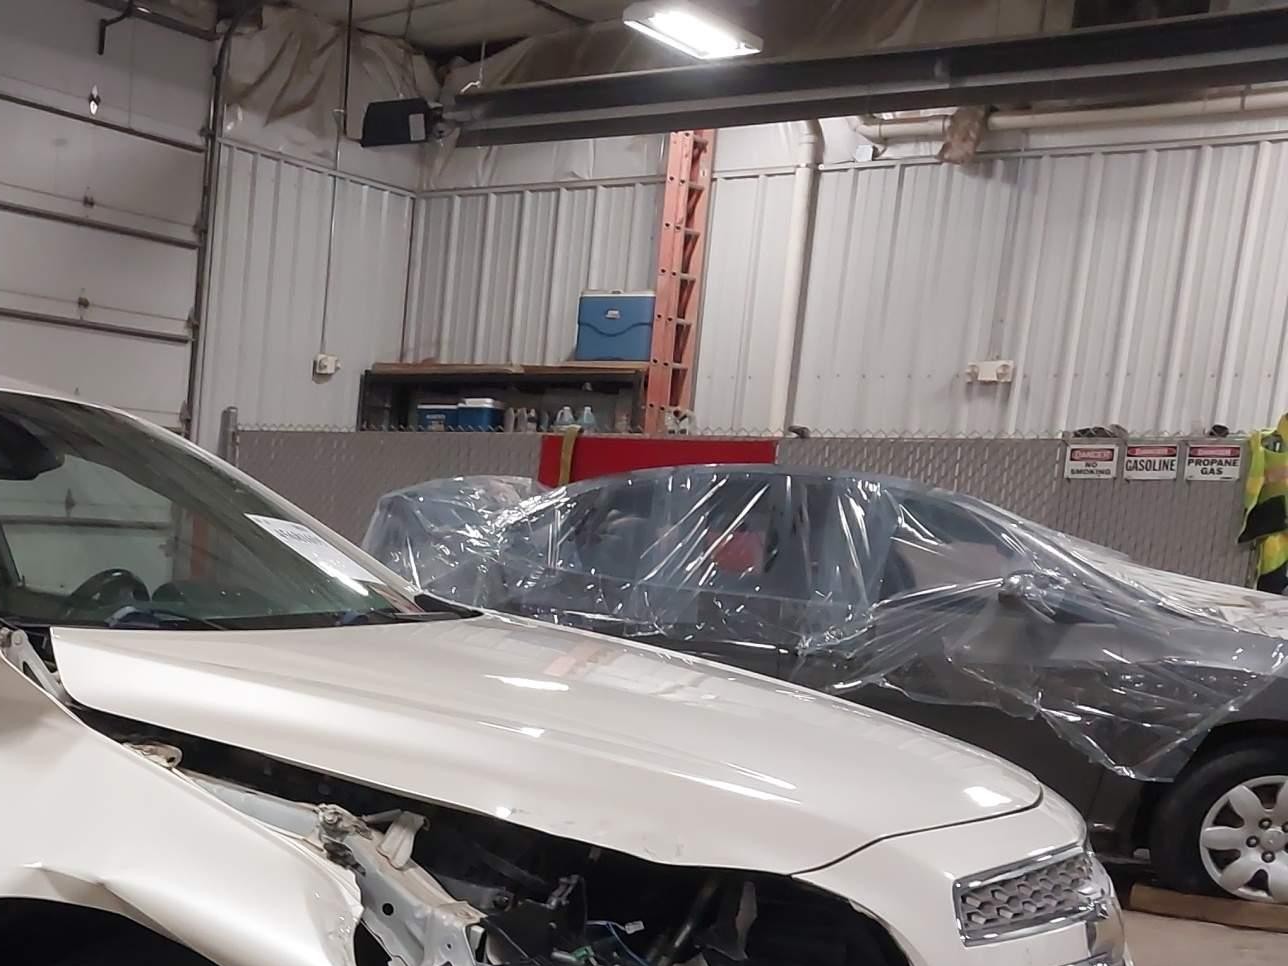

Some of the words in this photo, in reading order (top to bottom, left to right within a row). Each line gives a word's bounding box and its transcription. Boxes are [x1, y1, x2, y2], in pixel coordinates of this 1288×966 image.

[1125, 458, 1176, 472] GASOLINE
[1187, 458, 1239, 467] PROPANE
[1200, 467, 1224, 476] GAS
